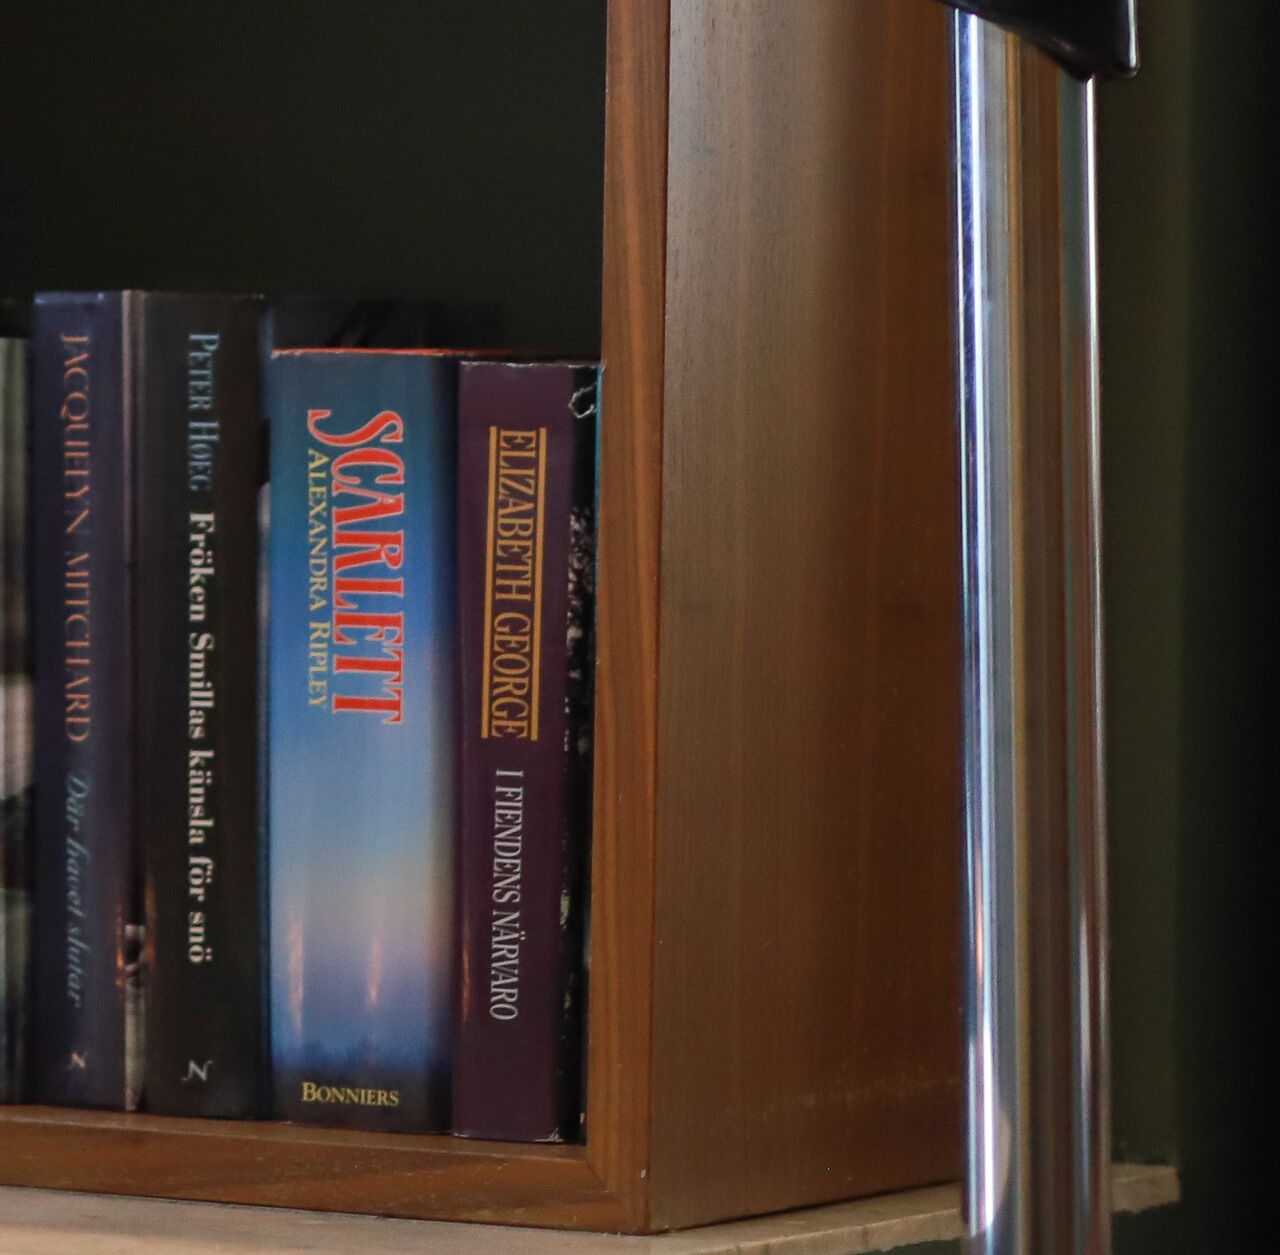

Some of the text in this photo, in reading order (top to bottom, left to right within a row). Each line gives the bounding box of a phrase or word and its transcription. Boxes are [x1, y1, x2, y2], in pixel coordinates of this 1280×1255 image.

[186, 332, 219, 411] PETER
[58, 334, 91, 743] JACQUELYN MITCHARD
[306, 448, 328, 709] ALEXANDRA RIPLEY
[308, 408, 405, 725] SCARLETT
[490, 428, 536, 739] ELIZABETH GEORGE
[187, 512, 216, 964] Fröken Smillas känsla för snö
[493, 784, 524, 904] FIENDENS
[302, 1081, 400, 1107] BONNIERS
[489, 910, 525, 1020] NÄRVARO
